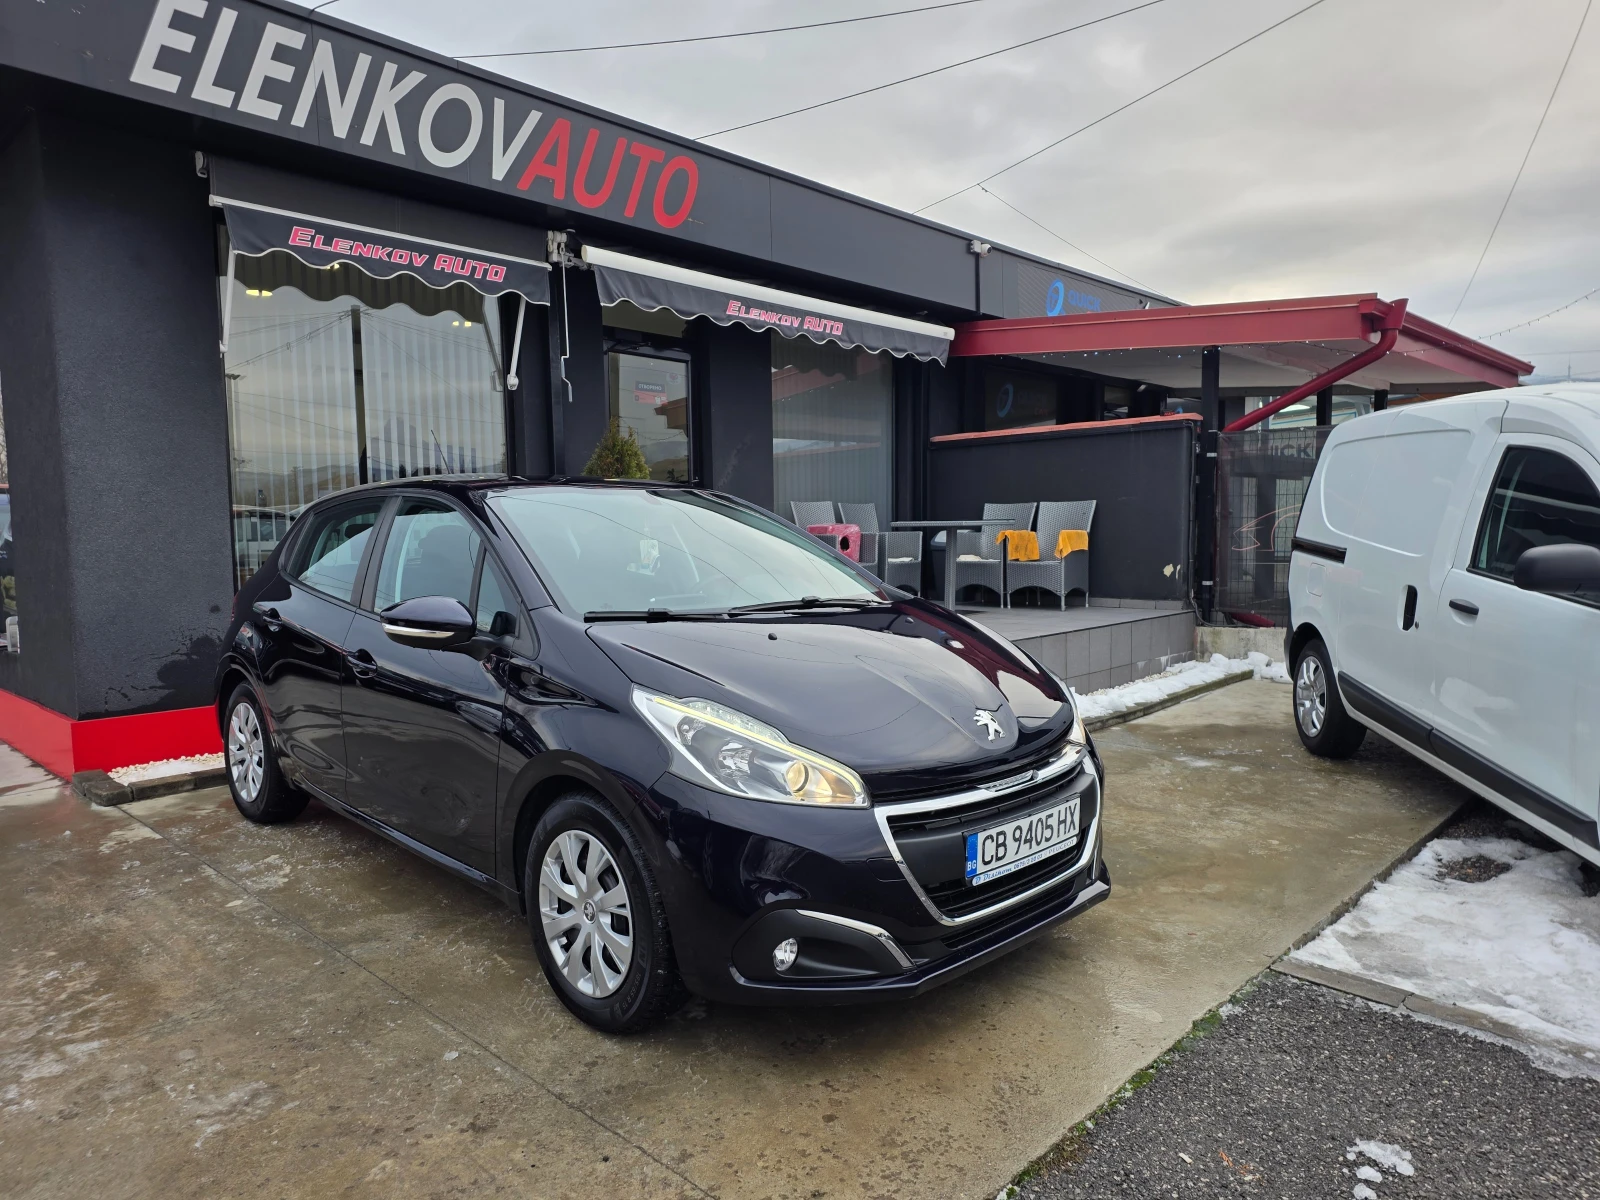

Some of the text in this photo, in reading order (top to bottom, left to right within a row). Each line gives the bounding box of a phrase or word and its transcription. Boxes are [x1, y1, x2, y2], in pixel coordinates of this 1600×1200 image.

[288, 225, 507, 283] ELENKOV AUTO
[726, 299, 844, 336] ELENKOV AUTO
[1068, 289, 1101, 312] QUICK
[982, 803, 1077, 866] CB 9405 HX
[967, 860, 977, 871] BG
